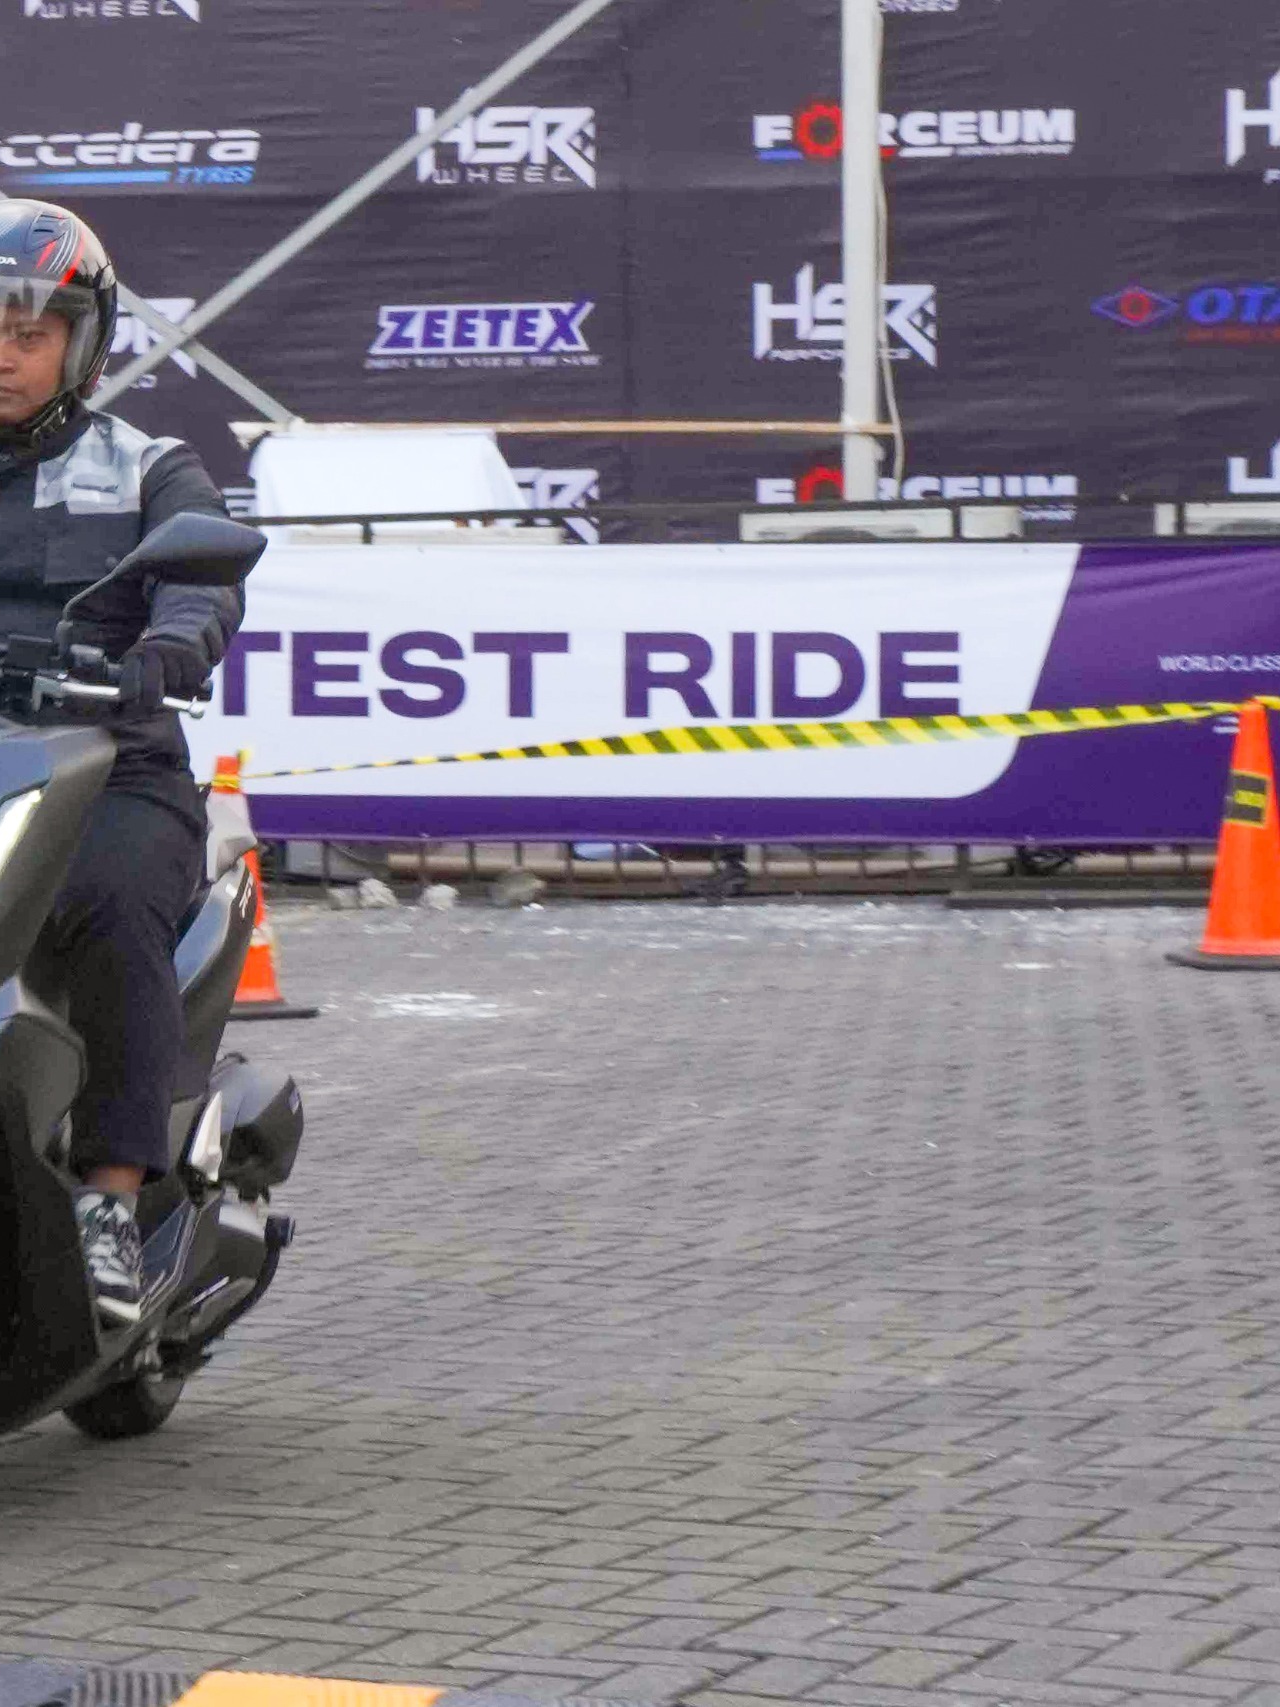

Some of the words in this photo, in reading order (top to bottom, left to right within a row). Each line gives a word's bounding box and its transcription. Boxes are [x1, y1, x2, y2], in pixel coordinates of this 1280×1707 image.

[177, 165, 257, 185] TYRES
[431, 166, 575, 184] WHEEL
[372, 299, 594, 354] ZEETEX
[1158, 654, 1227, 672] WORLD
[220, 631, 570, 718] TEST
[623, 631, 960, 718] RIDE
